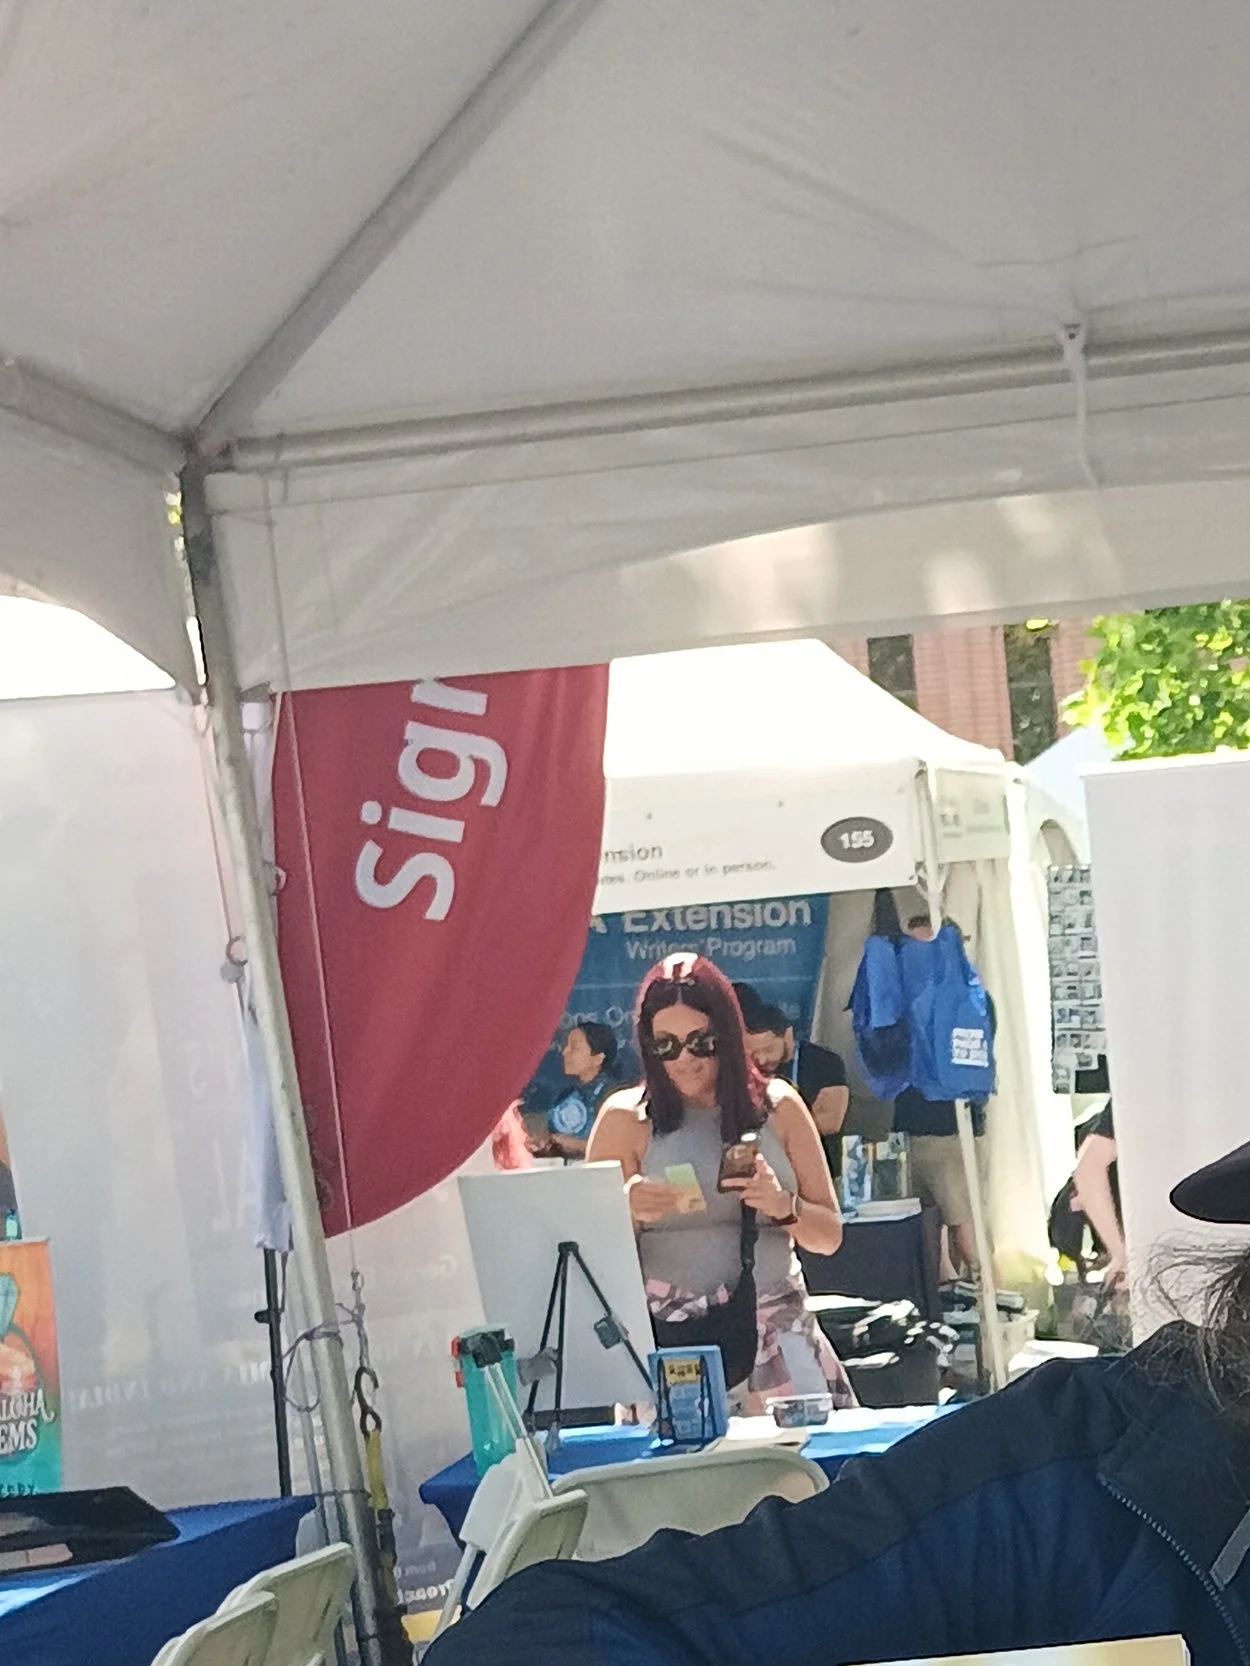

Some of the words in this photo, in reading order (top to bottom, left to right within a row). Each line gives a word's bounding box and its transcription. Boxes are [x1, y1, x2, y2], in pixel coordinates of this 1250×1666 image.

[836, 830, 875, 849] 155
[604, 844, 663, 863] nsion
[623, 900, 811, 933] Extension
[706, 937, 796, 960] Program
[0, 1417, 38, 1455] EMS
